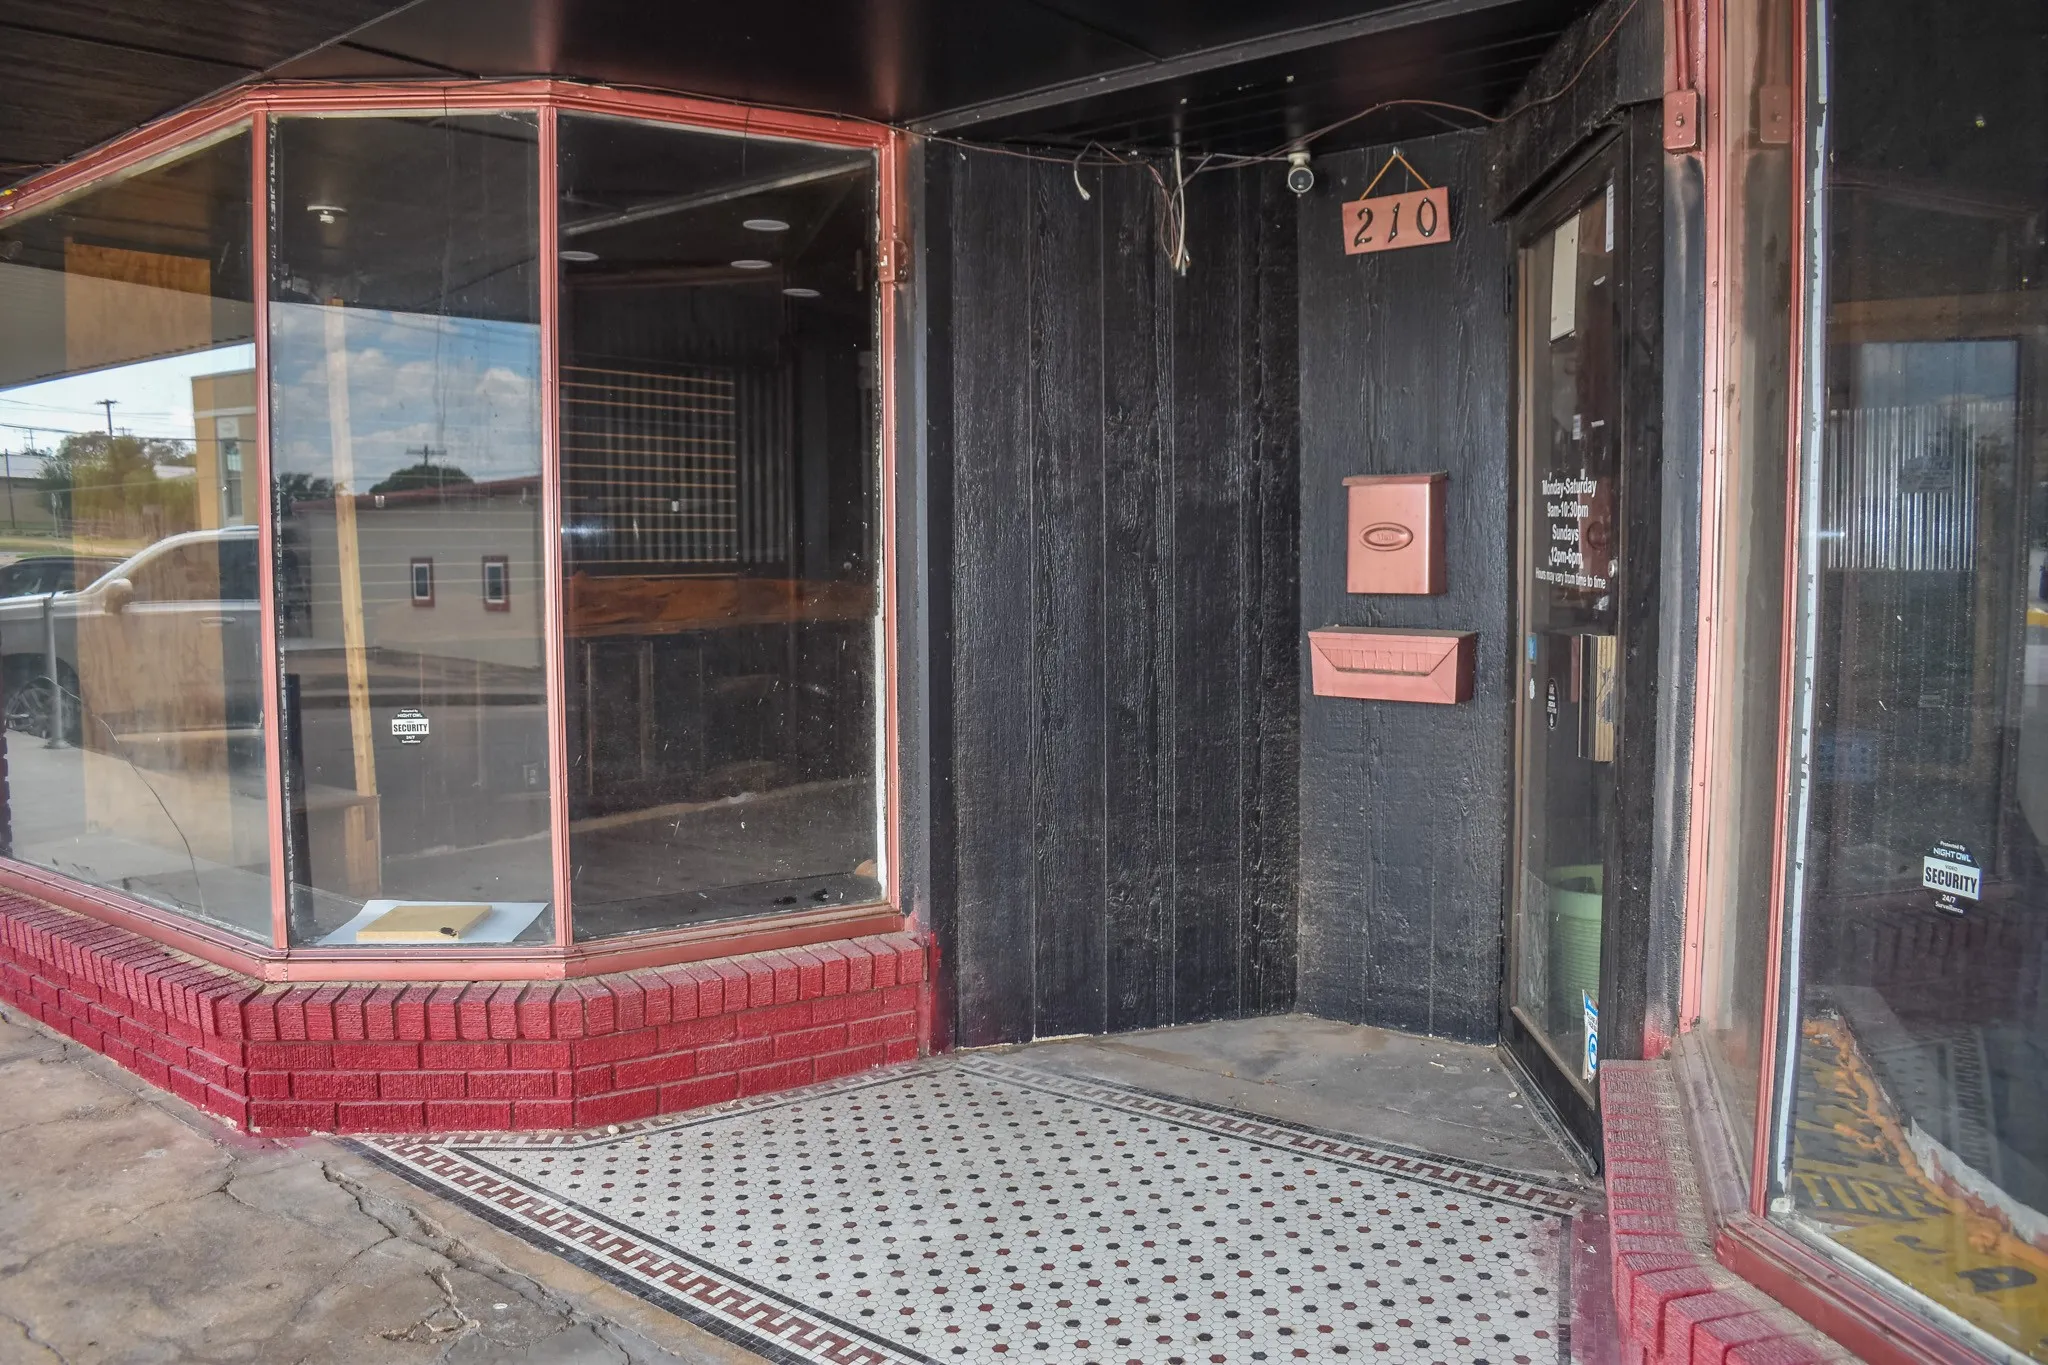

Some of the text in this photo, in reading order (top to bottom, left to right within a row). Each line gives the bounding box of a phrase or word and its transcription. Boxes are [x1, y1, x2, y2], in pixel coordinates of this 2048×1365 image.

[1354, 197, 1437, 247] 210
[1542, 478, 1597, 498] Monday-Saturday
[1547, 501, 1589, 521] 9am-10:30pm
[1552, 524, 1579, 545] Sundays
[1564, 571, 1576, 585] from
[1587, 575, 1594, 588] to
[1594, 575, 1606, 589] time
[393, 723, 428, 732] SECURITY
[1933, 847, 1972, 863] NIGHT OWL
[1925, 866, 1978, 894] SECURITY
[1935, 901, 1964, 914] Surveillance
[1942, 894, 1956, 904] 24/7
